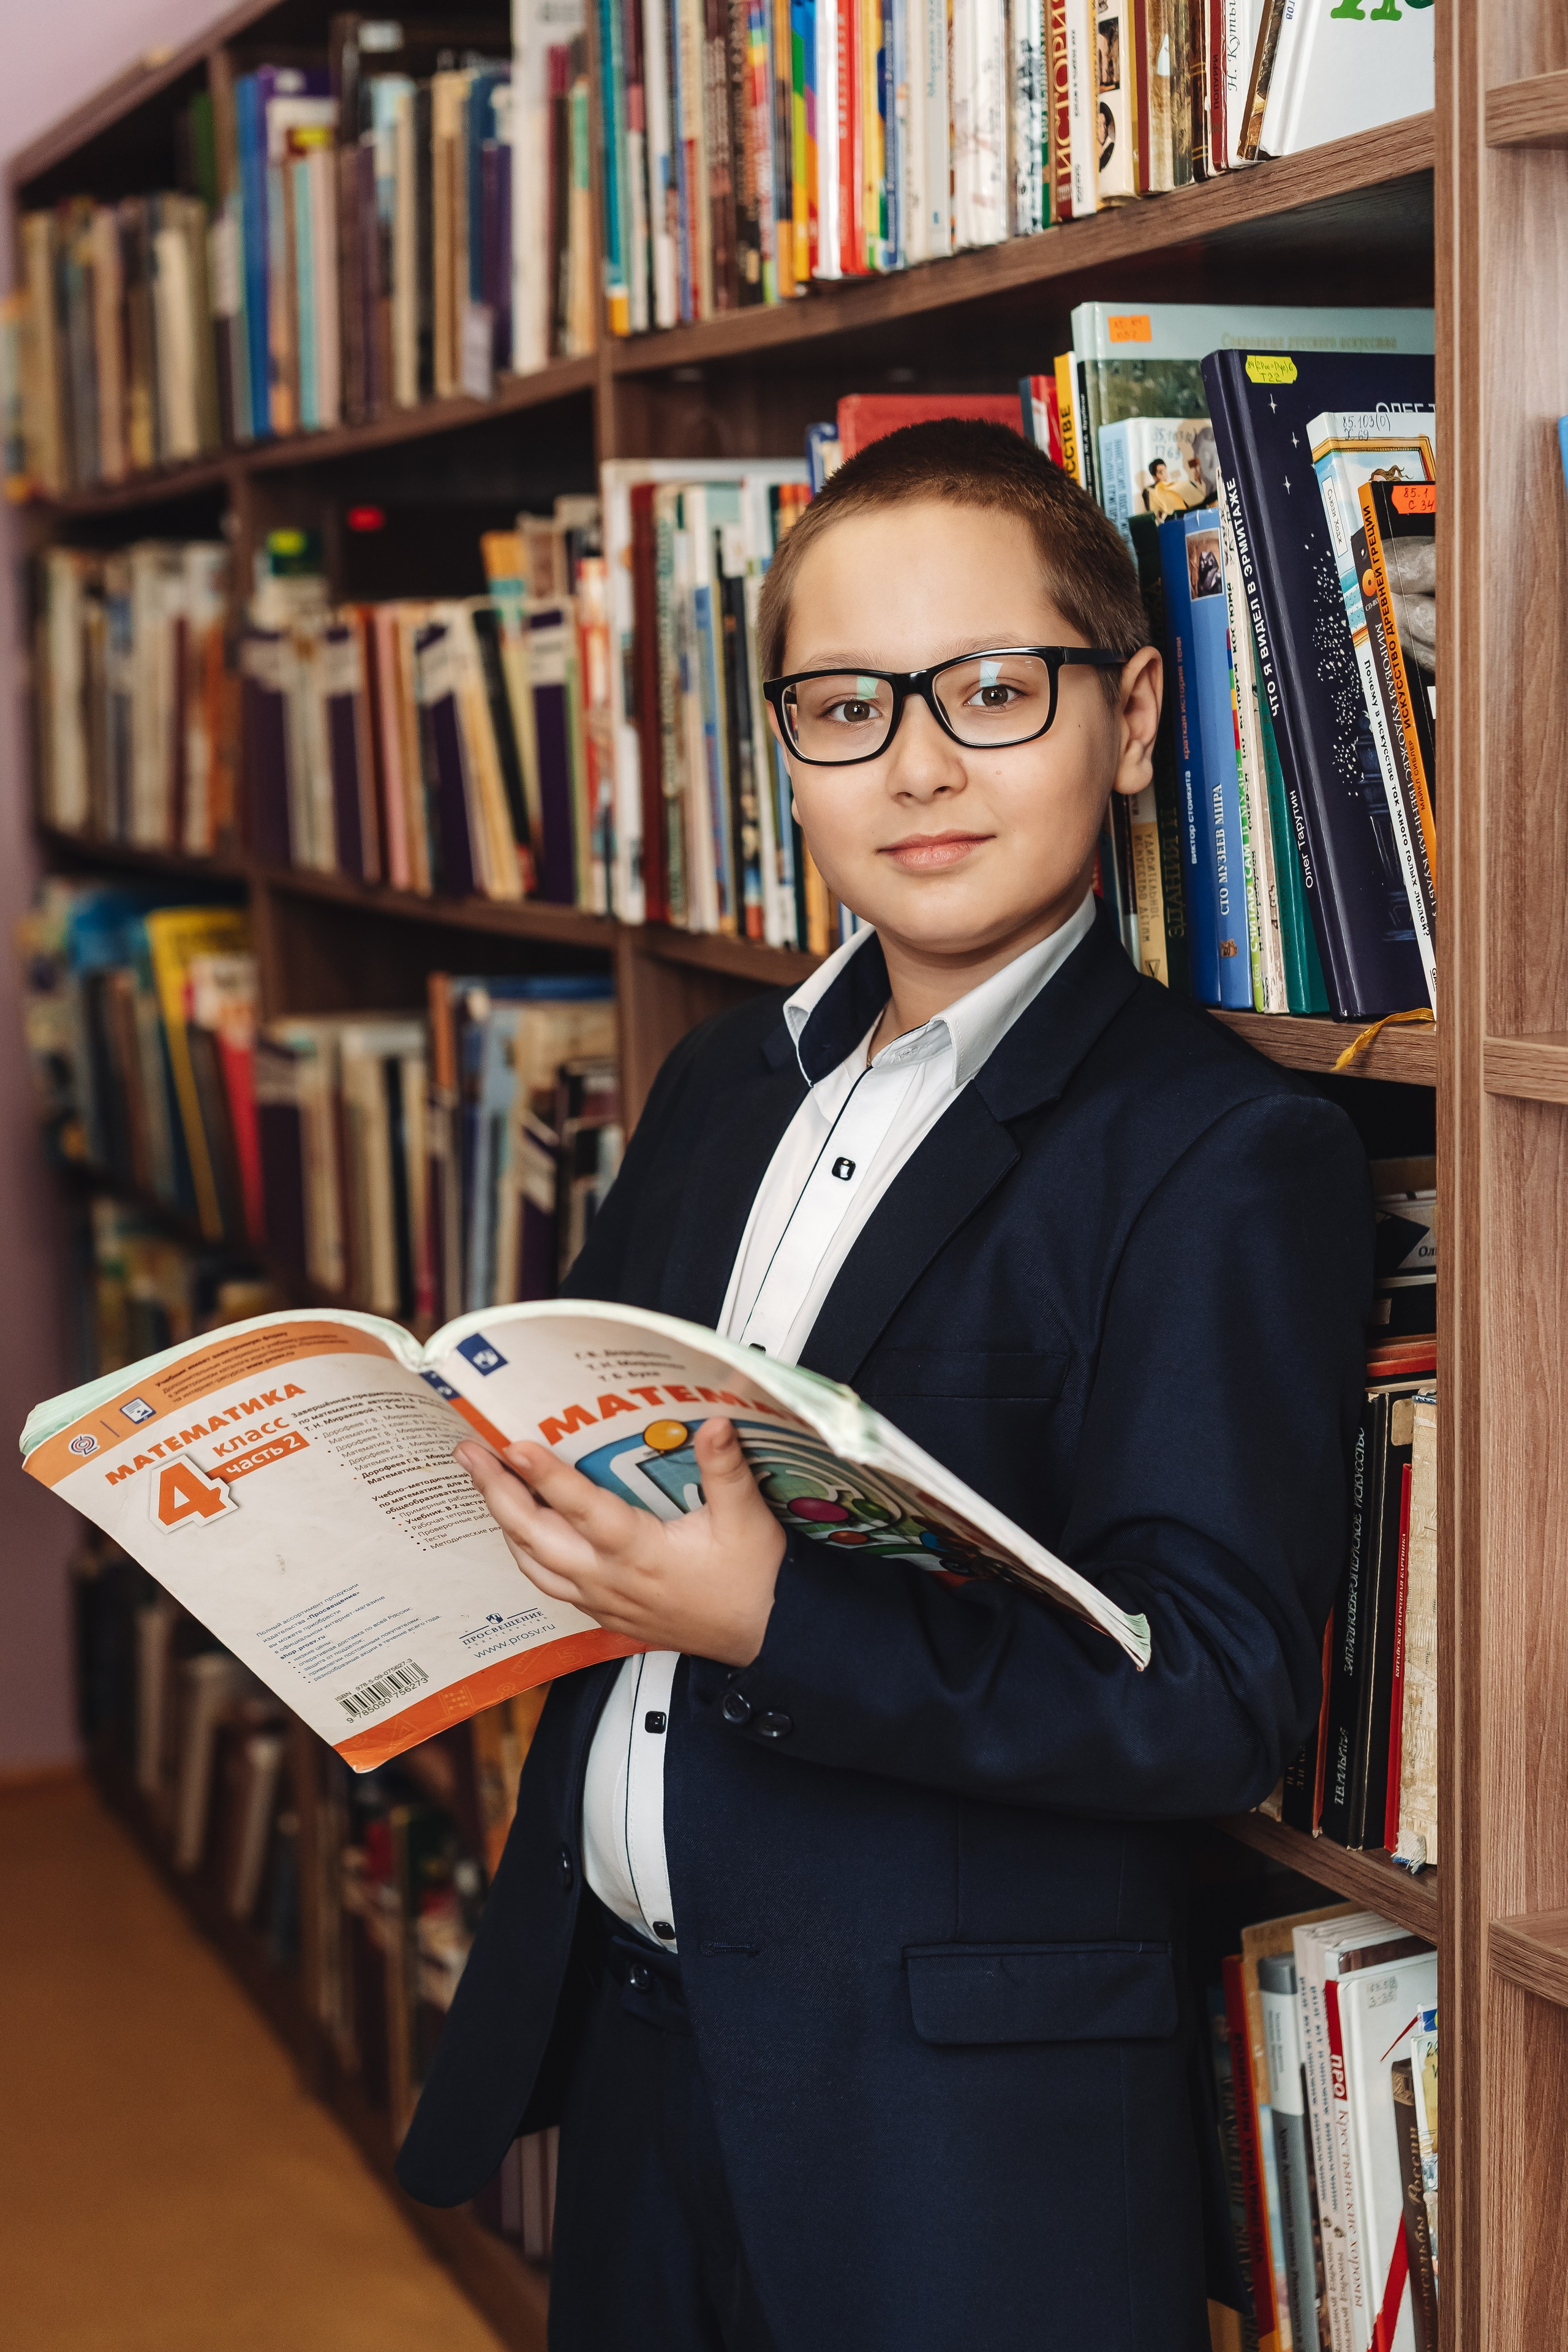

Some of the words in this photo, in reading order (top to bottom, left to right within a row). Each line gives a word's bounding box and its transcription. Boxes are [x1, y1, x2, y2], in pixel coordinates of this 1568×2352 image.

[1052, 0, 1072, 176] ИСТОРИ
[1343, 413, 1391, 432] 85.103(0)
[1226, 477, 1253, 577] ЭРМИТАЖЕ
[1327, 489, 1337, 518] Сьюзи
[1334, 519, 1344, 545] Ходж
[1362, 505, 1382, 567] ГРЕЦИИ
[1246, 581, 1257, 595] В
[1374, 568, 1396, 635] ДРЕВНЕЙ
[1250, 598, 1270, 659] ВИДЕЛ
[1263, 662, 1273, 676] Я
[1389, 640, 1411, 729] ИСКУССТВО
[1267, 682, 1280, 717] ЧТО
[1375, 623, 1396, 701] МИРОВАЯ
[1391, 704, 1427, 861] ХУДОЖЕСТВЕННАЯ
[1408, 739, 1420, 777] СИБЛЕР
[1212, 783, 1225, 824] МИРА
[1364, 659, 1378, 706] Почему
[1378, 720, 1394, 782] искусстве
[1396, 810, 1408, 846] много
[1405, 850, 1417, 887] голых
[1414, 890, 1430, 937] людей?
[1414, 778, 1426, 811] МАЙКЛ
[1289, 790, 1311, 858] Тарутин
[1215, 829, 1229, 883] МУЗЕЕВ
[1243, 843, 1253, 880] САМ
[1300, 859, 1314, 889] Олег
[1220, 888, 1230, 916] СТО
[1246, 886, 1259, 952] СЧИТАЮ
[105, 1383, 307, 1487] МАТЕМАТИКА
[212, 1417, 290, 1458] класс
[322, 1422, 364, 1439] Дорофеев
[328, 1427, 381, 1445] Математика.
[335, 1435, 377, 1452] Дорофеев
[225, 1447, 284, 1474] часть
[282, 1435, 301, 1449] 2
[341, 1440, 394, 1458] Математика.
[348, 1449, 391, 1466] Дорофеев
[354, 1453, 407, 1472] Математика.
[361, 1461, 406, 1479] Дорофеев
[367, 1465, 424, 1485] Математика.
[371, 1472, 470, 1502] Учебно-методический
[158, 1462, 227, 1526] 4
[379, 1500, 391, 1509] по
[391, 1484, 443, 1504] математике
[399, 1499, 447, 1519] Примерные
[448, 1492, 481, 1504] рабочие
[404, 1508, 446, 1525] Учебник.
[411, 1517, 445, 1532] Рабочая
[445, 1508, 478, 1520] тетрадь.
[418, 1517, 473, 1538] Проверочные
[423, 1532, 448, 1543] Тесты
[430, 1529, 488, 1550] Методические
[256, 1621, 282, 1637] Полный
[282, 1601, 324, 1624] ассортимент
[324, 1583, 360, 1603] продукции
[263, 1619, 306, 1643] издательства
[306, 1591, 360, 1621] «Просвещение»
[278, 1629, 303, 1644] можете
[303, 1609, 341, 1632] приобрести
[279, 1627, 324, 1652] официальном
[324, 1595, 386, 1629] интернет-магазине
[462, 1610, 545, 1646] ПРОСВЕЩЕНИЕ
[293, 1648, 315, 1662] низкие
[315, 1640, 333, 1651] цены;
[298, 1645, 337, 1667] оперативная
[337, 1630, 364, 1648] доставка
[373, 1617, 388, 1627] всей
[388, 1607, 413, 1620] России;
[303, 1659, 326, 1672] защита
[334, 1638, 365, 1657] подделок;
[308, 1657, 344, 1677] привилегии
[344, 1636, 381, 1660] постоянным
[380, 1617, 422, 1640] покупателям;
[313, 1655, 360, 1683] разнообразные
[360, 1645, 379, 1658] акции
[383, 1629, 407, 1645] течение
[407, 1621, 426, 1633] всего
[425, 1614, 442, 1625] года.
[473, 1623, 556, 1659] www.prosv.ru
[334, 1691, 352, 1702] ISBN
[355, 1657, 413, 1692] 978-5-09-075627-3
[356, 1697, 391, 1719] 785090
[393, 1677, 429, 1699] 756273
[1329, 2054, 1345, 2098] ПРО
